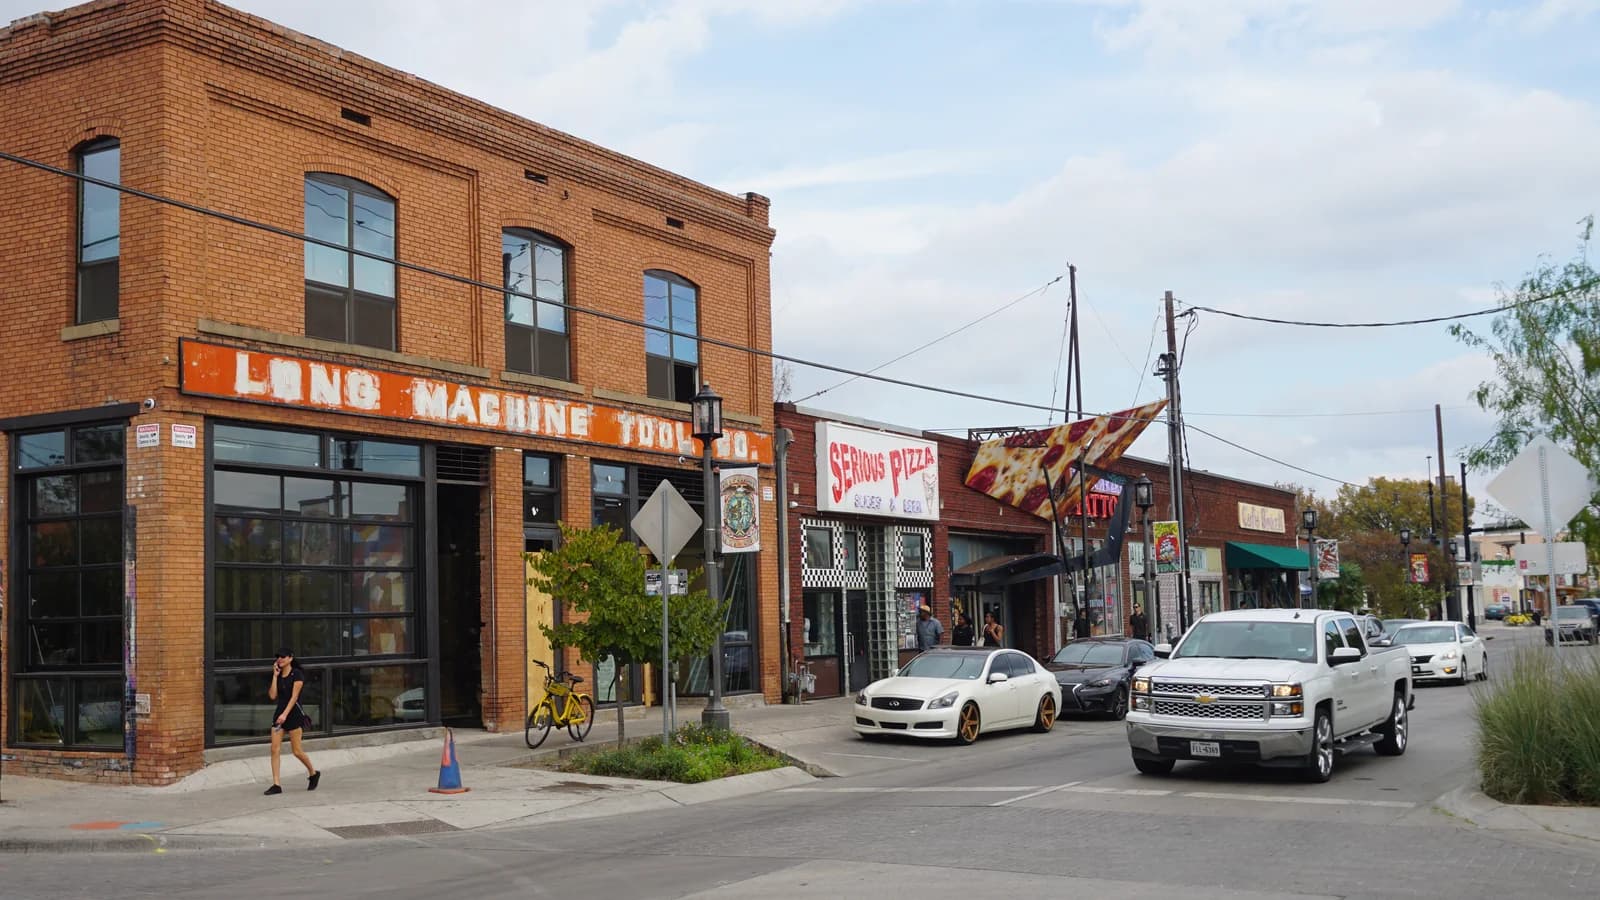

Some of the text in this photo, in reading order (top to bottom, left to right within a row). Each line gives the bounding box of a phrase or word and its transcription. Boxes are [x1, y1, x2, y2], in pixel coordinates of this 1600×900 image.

[234, 350, 381, 411] LONG
[411, 377, 590, 438] MACHINE
[618, 411, 695, 456] TOOL
[829, 441, 935, 504] SERIOUS PIZZA
